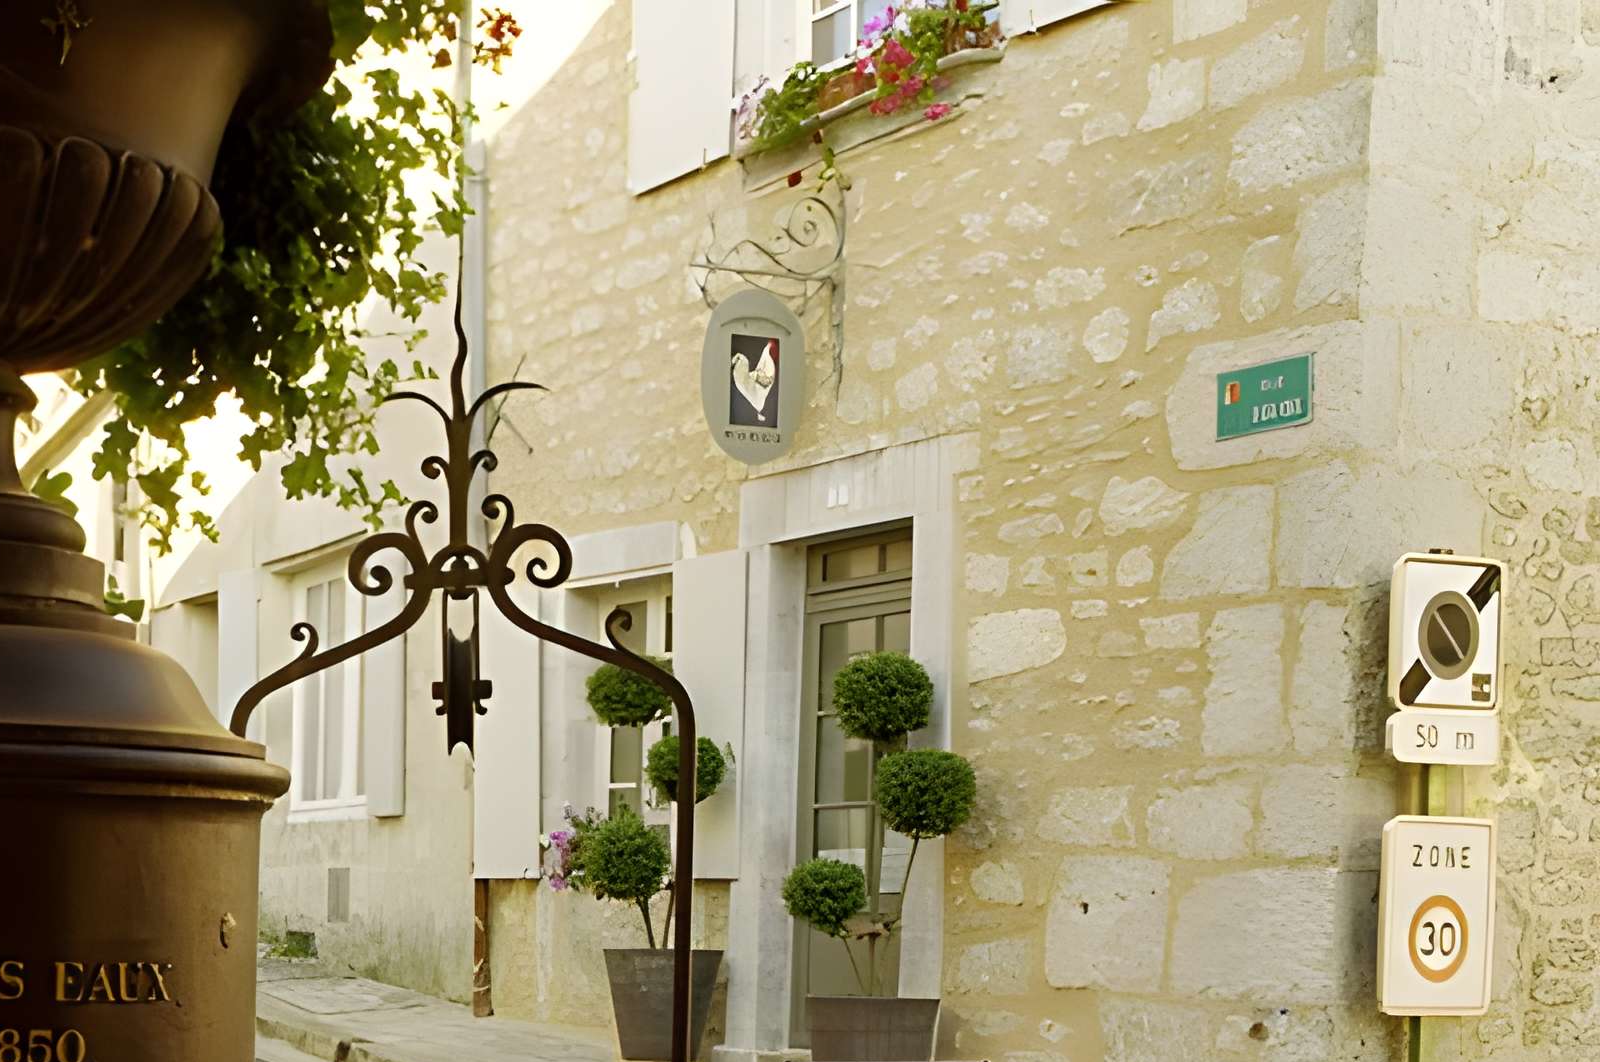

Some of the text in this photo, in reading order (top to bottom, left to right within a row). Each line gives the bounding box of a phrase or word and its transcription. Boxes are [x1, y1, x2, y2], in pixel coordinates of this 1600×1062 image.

[1455, 731, 1475, 751] m
[1411, 844, 1472, 870] ZONE
[1420, 920, 1457, 957] 30
[54, 960, 173, 1002] EAUX
